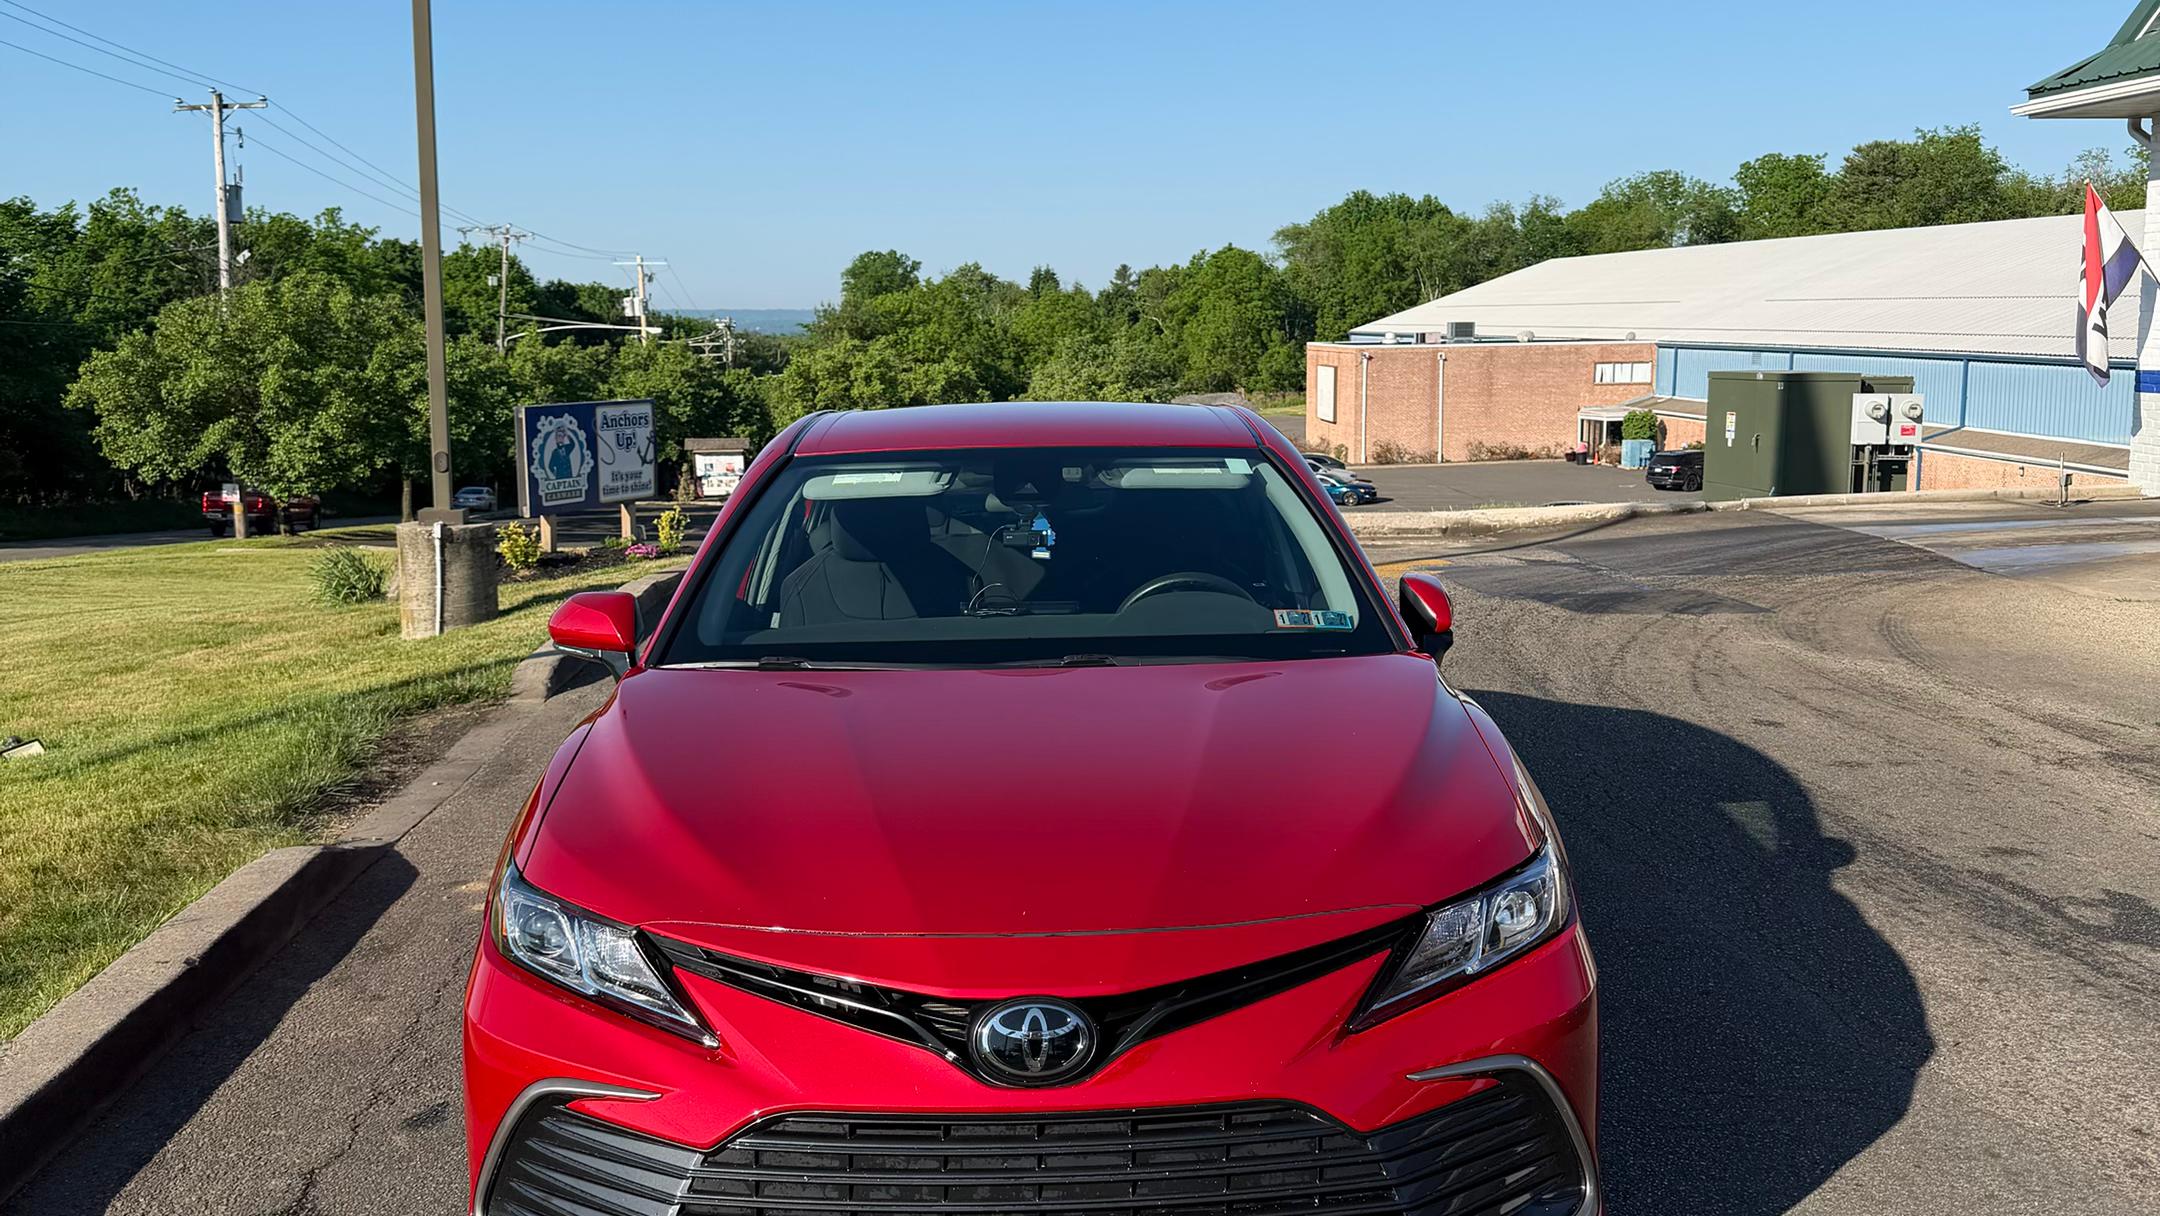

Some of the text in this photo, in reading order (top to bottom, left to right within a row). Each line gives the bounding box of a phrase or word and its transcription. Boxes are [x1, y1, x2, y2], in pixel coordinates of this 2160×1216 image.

[601, 413, 649, 429] Anchors
[616, 431, 636, 450] Up!
[611, 470, 643, 482] It's your
[545, 479, 582, 491] CAPTAIN
[602, 484, 620, 496] time
[620, 483, 630, 494] to
